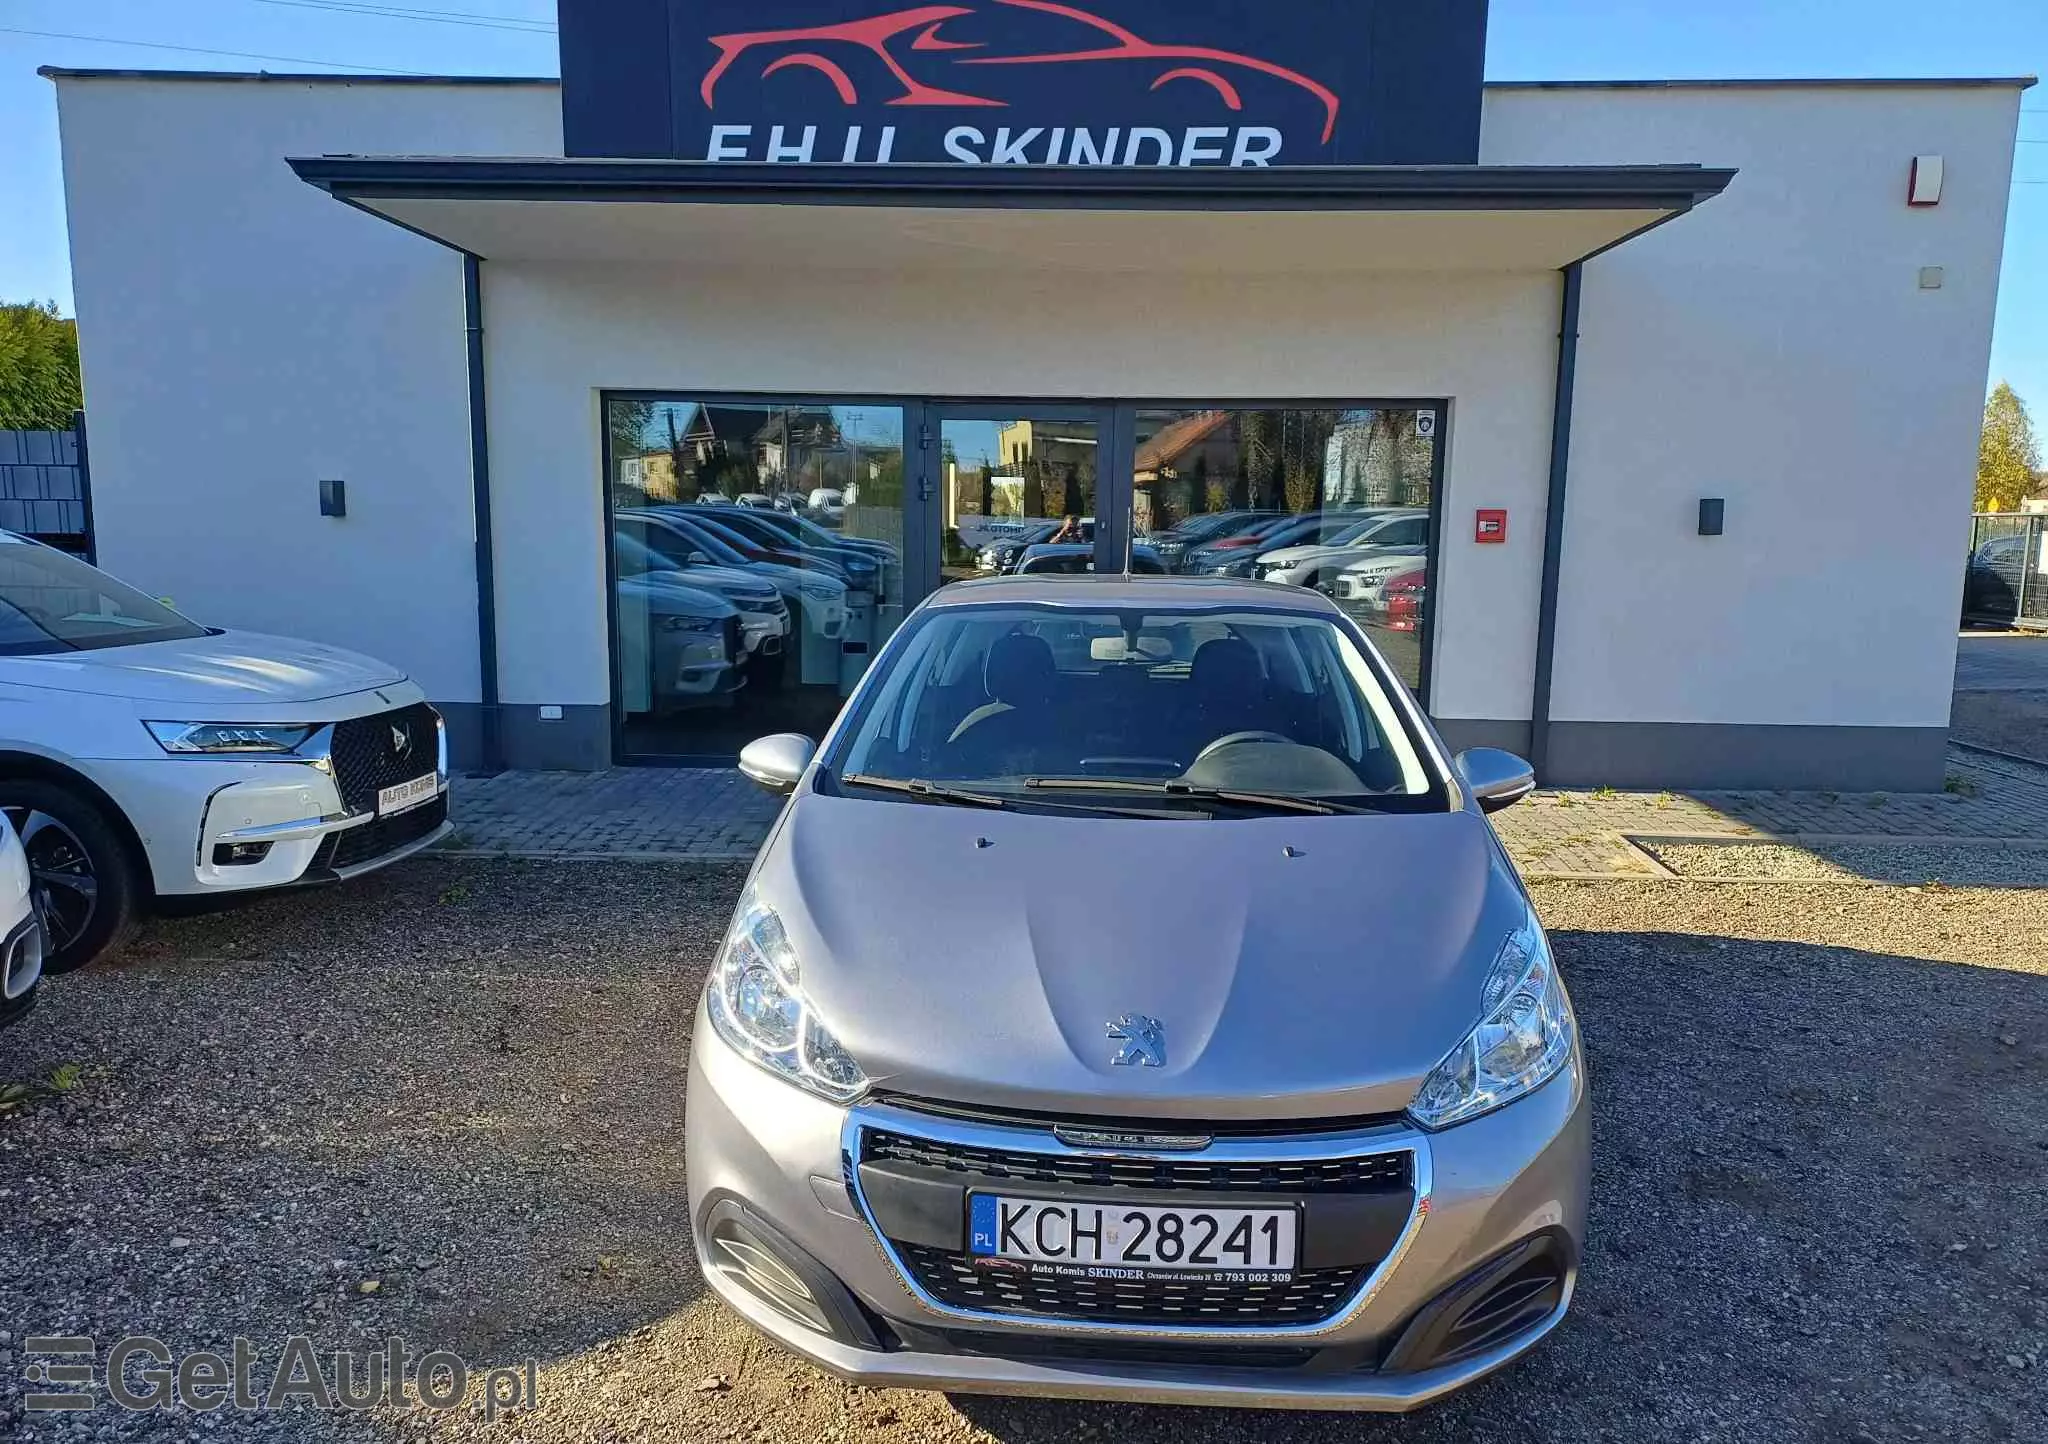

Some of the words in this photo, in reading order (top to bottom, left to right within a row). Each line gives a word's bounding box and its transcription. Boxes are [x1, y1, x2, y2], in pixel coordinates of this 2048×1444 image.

[943, 125, 1283, 167] SKINDER
[974, 1233, 993, 1247] PL
[1000, 1203, 1102, 1260] KCH
[1122, 1211, 1279, 1265] 28241
[1032, 1263, 1053, 1274] Auto
[1056, 1265, 1085, 1276] Komis
[1088, 1267, 1145, 1280] SKINDER
[1225, 1273, 1245, 1282] 793
[1248, 1273, 1269, 1282] 002
[1271, 1273, 1292, 1282] 309
